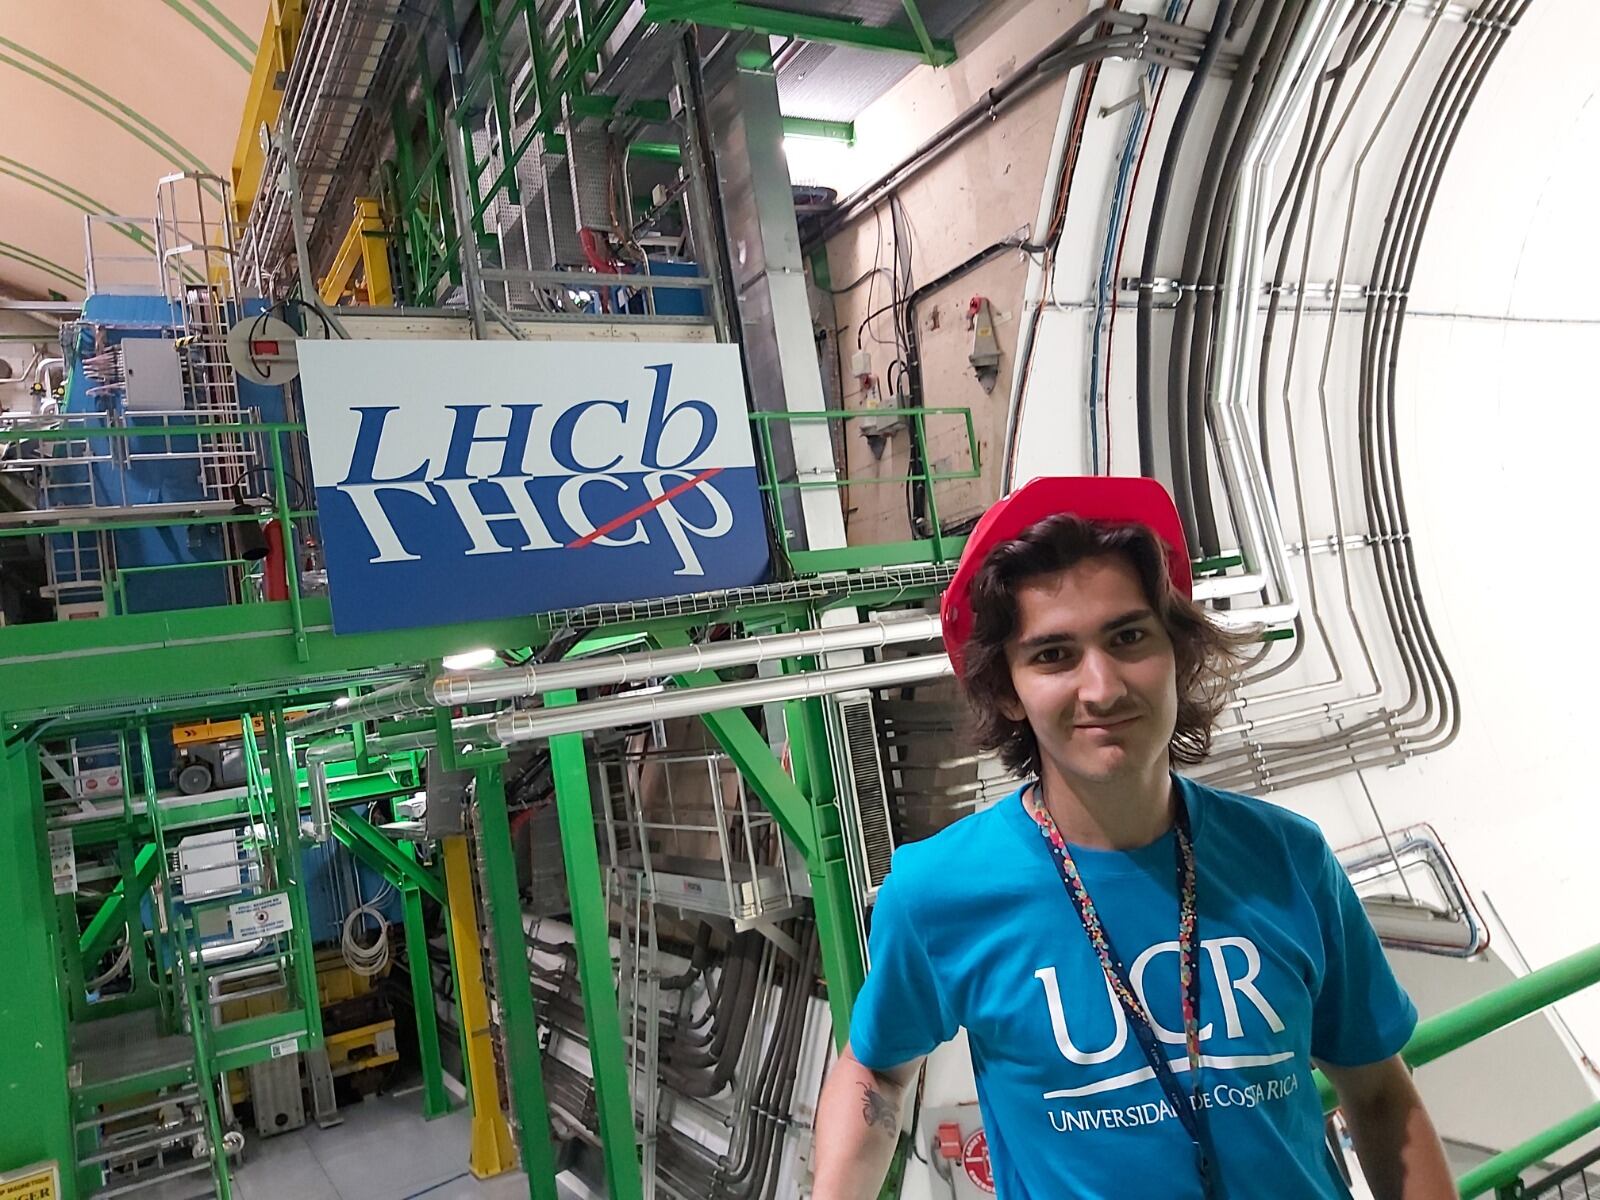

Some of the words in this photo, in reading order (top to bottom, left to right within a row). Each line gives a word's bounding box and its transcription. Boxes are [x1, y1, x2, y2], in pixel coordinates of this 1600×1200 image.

[337, 363, 718, 485] LHCb
[1034, 937, 1285, 1065] UCR
[1267, 1073, 1298, 1100] RICA
